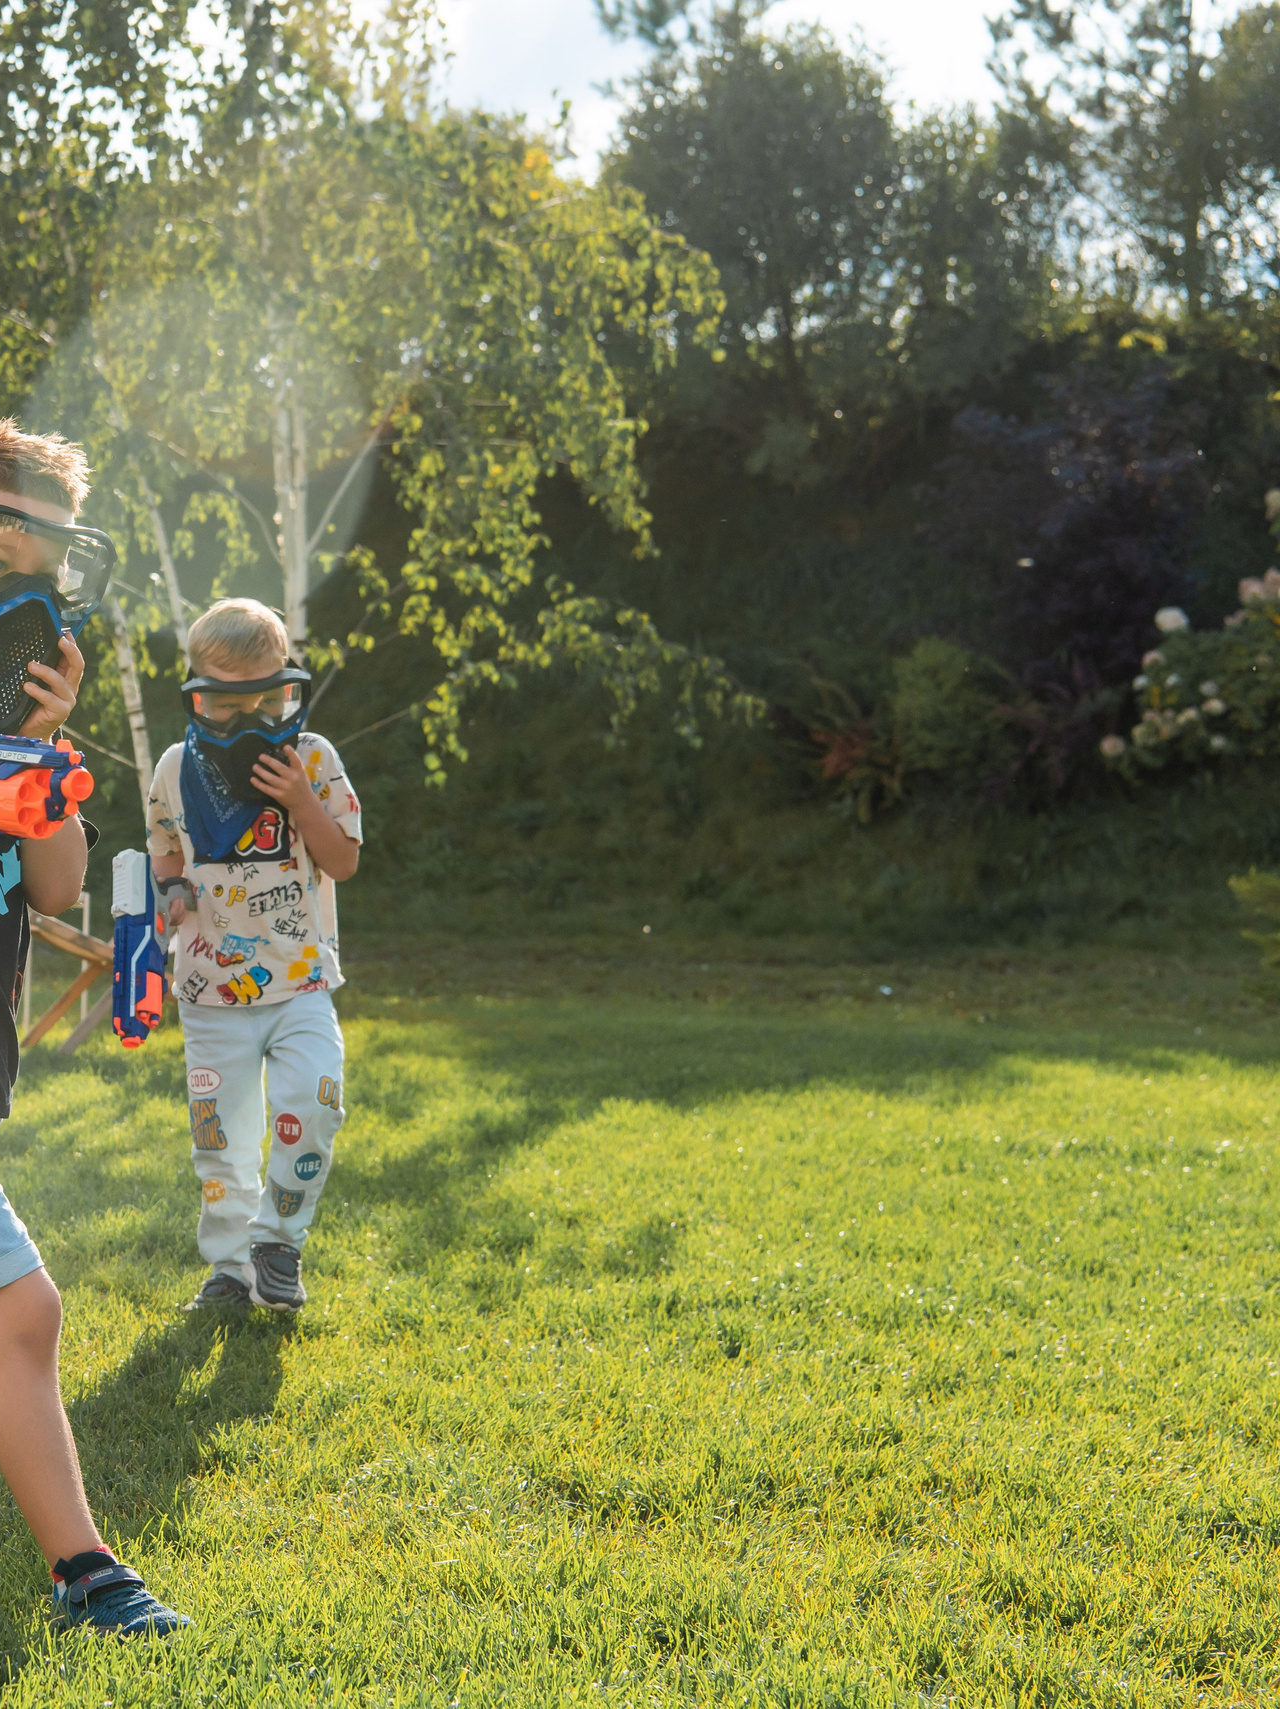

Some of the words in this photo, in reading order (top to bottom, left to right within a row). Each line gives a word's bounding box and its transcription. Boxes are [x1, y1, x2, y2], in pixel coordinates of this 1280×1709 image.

[190, 1074, 213, 1087] COOL
[276, 1121, 300, 1136] FUN
[296, 1159, 321, 1173] VIBE
